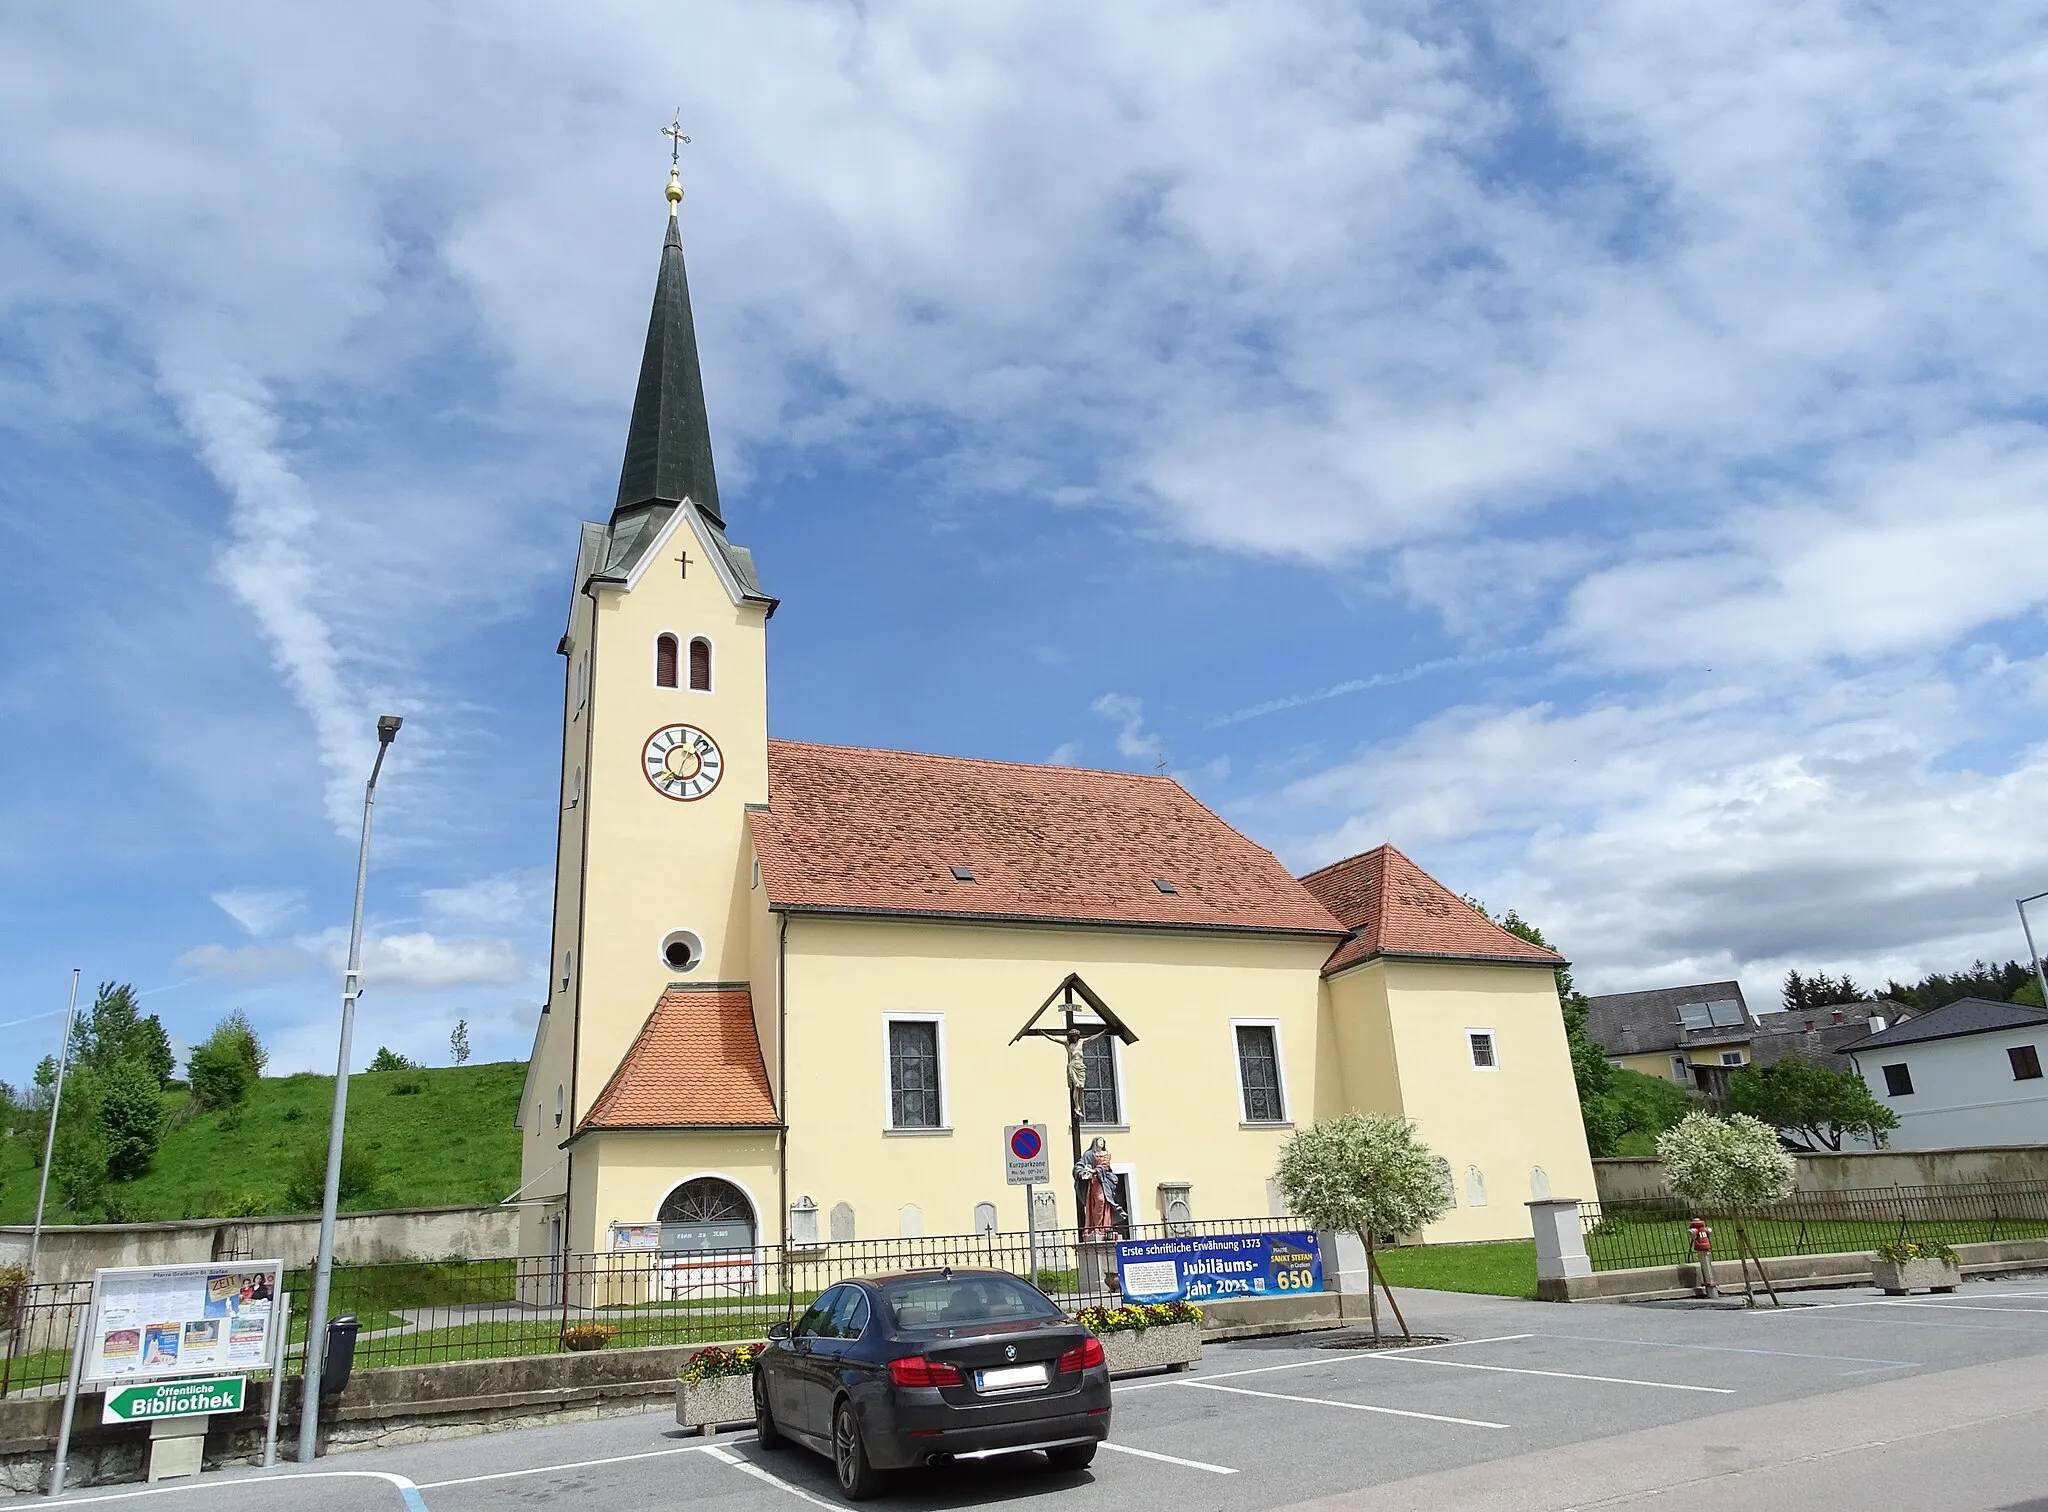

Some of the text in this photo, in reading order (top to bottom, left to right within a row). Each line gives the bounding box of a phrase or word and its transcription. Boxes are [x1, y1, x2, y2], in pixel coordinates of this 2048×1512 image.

[1121, 1238, 1261, 1257] Erste schriftliche Erwähnung 1373
[1183, 1258, 1259, 1276] Jubiläums-
[1270, 1253, 1313, 1263] SANKT STEFAN
[211, 1275, 236, 1291] ZEIT
[1277, 1269, 1313, 1290] 650
[1185, 1279, 1249, 1300] jahr 2023
[156, 1384, 215, 1398] Öffentliche
[131, 1392, 234, 1415] Bibliothek
